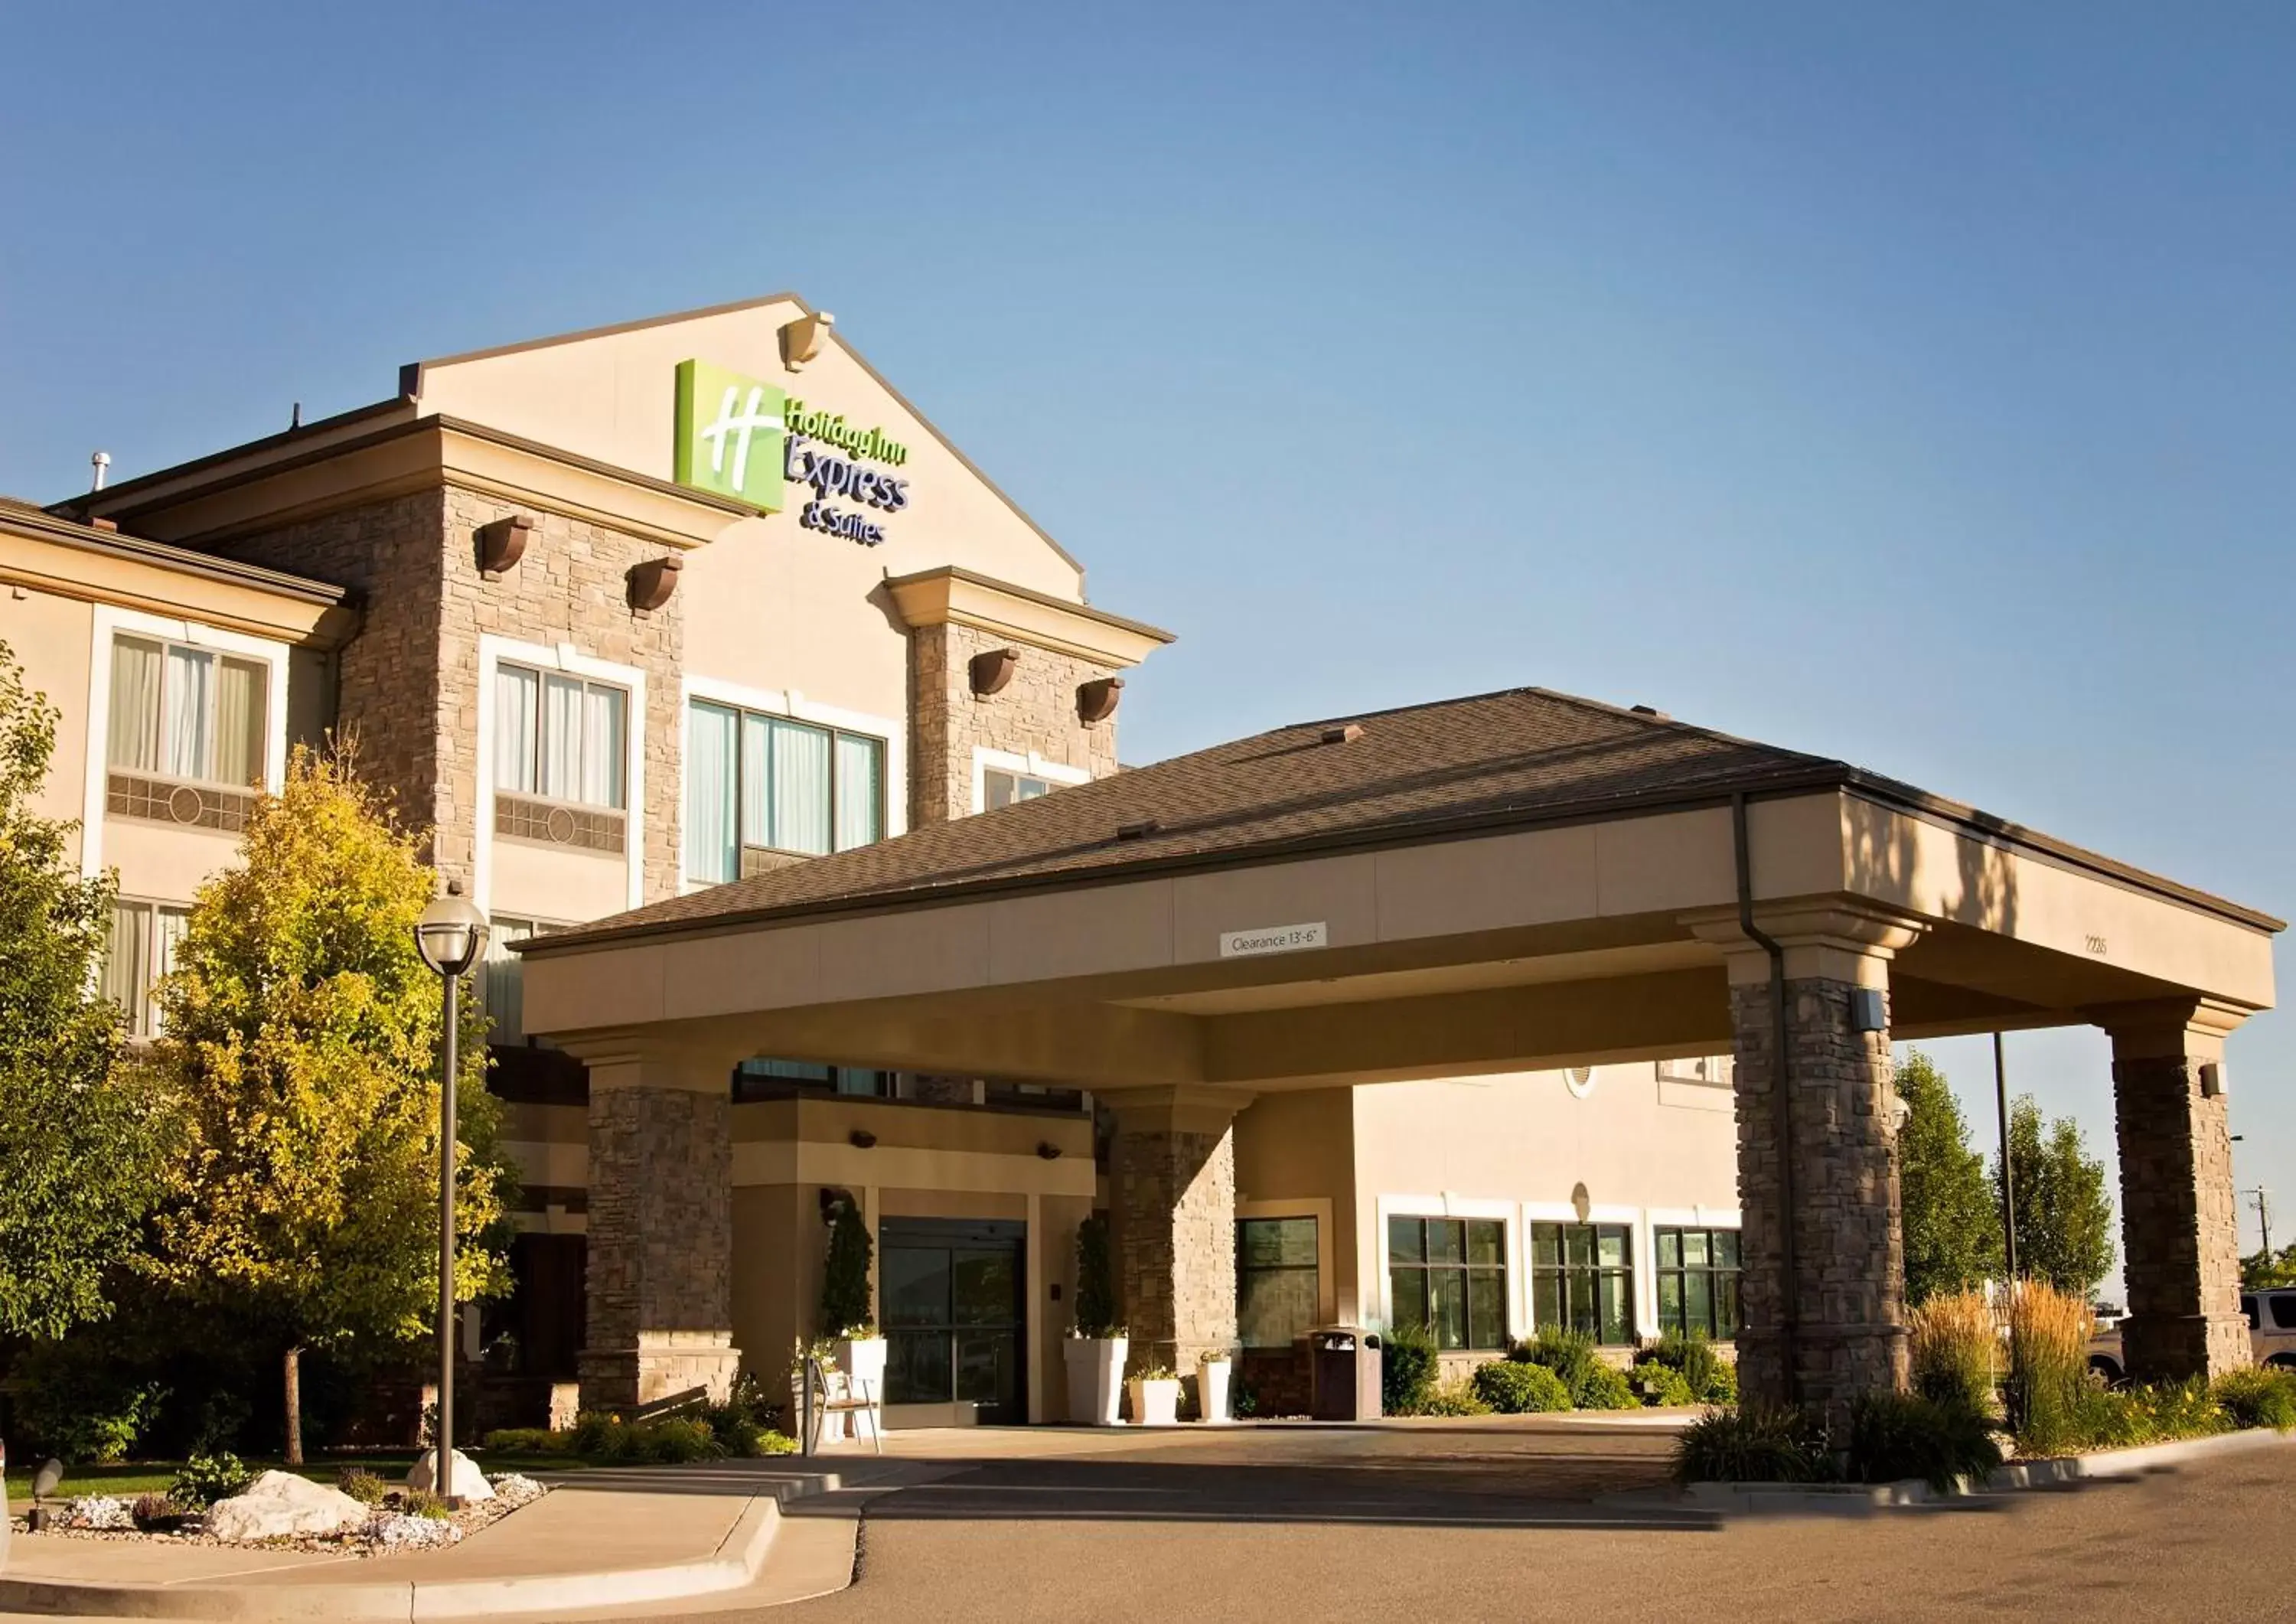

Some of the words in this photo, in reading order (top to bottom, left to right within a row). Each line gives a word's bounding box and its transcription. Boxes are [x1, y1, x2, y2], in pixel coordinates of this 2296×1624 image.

[784, 397, 873, 460] Holiday
[872, 426, 907, 466] Inn
[784, 434, 909, 513] Express
[799, 501, 821, 529] &
[820, 505, 887, 547] Suites
[1231, 935, 1285, 951] Clearance
